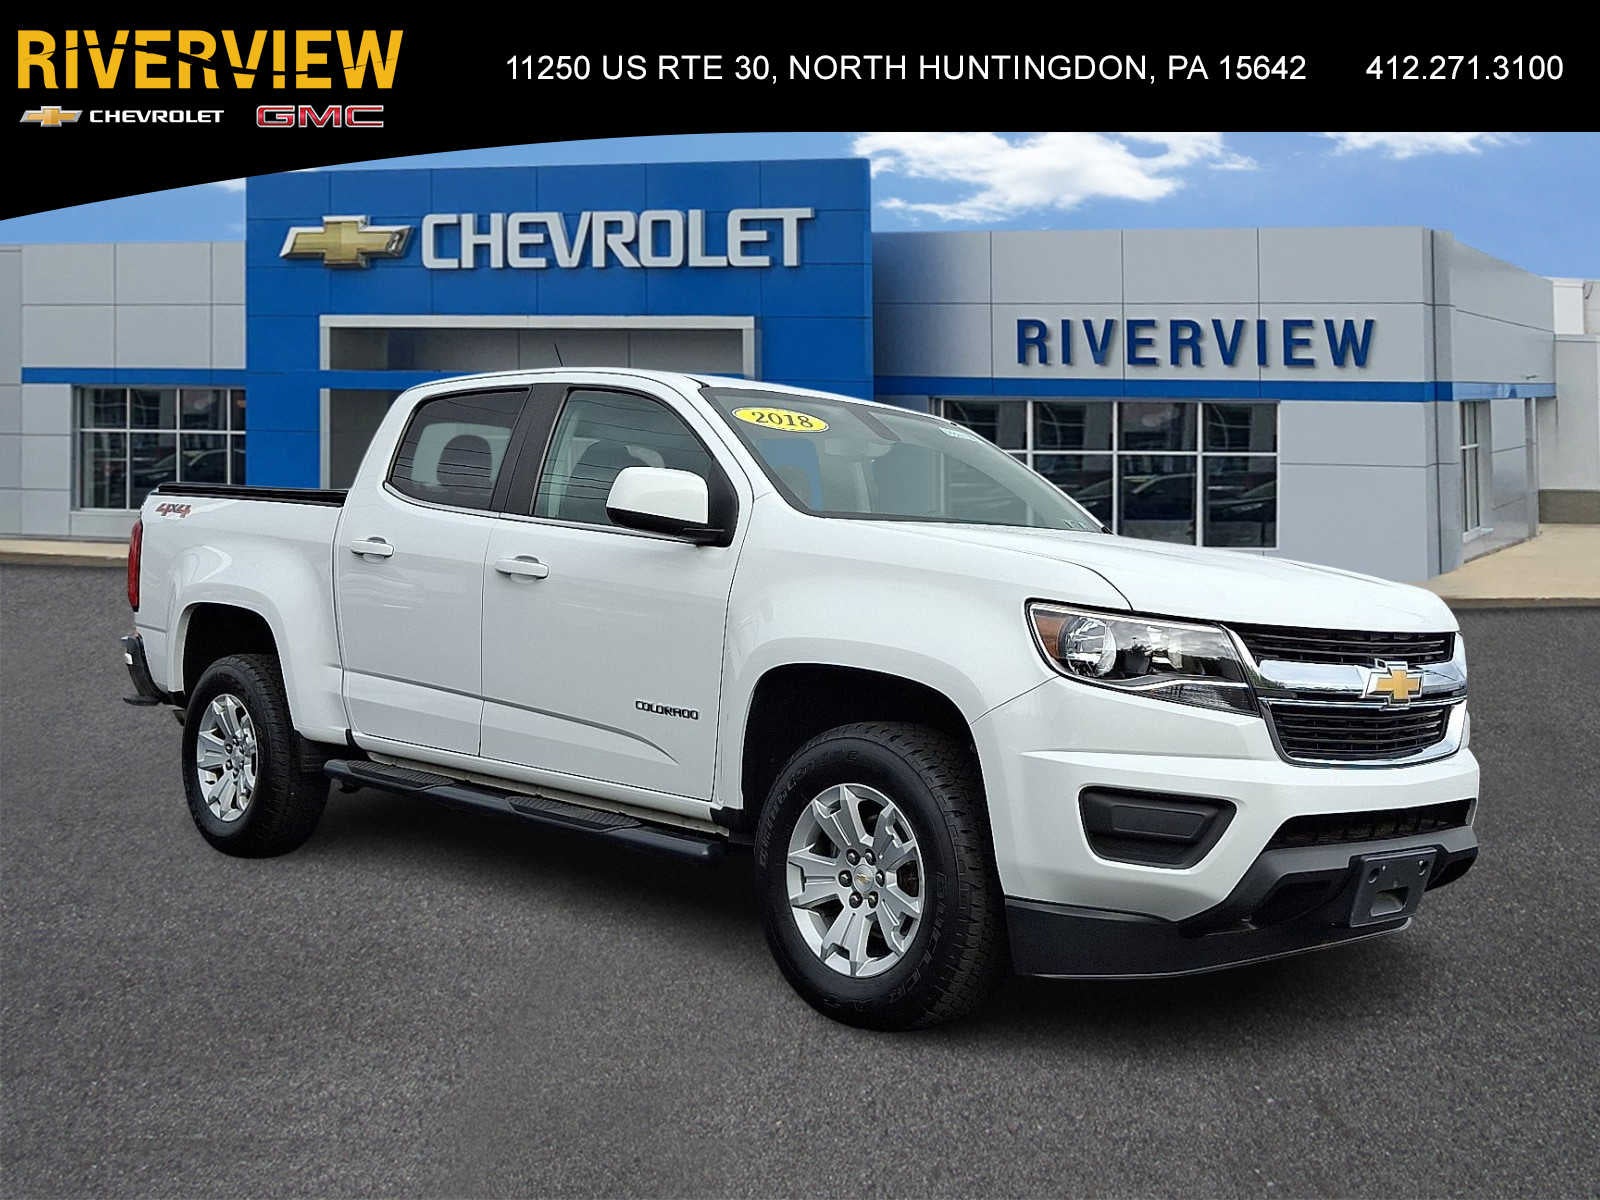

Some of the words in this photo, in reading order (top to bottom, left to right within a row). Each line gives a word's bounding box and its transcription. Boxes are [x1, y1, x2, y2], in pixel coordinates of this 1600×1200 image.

[421, 207, 814, 269] CHEVROLET
[1016, 318, 1376, 368] RIVERVIEW
[751, 411, 814, 429] 2018
[635, 700, 699, 721] COLORADO
